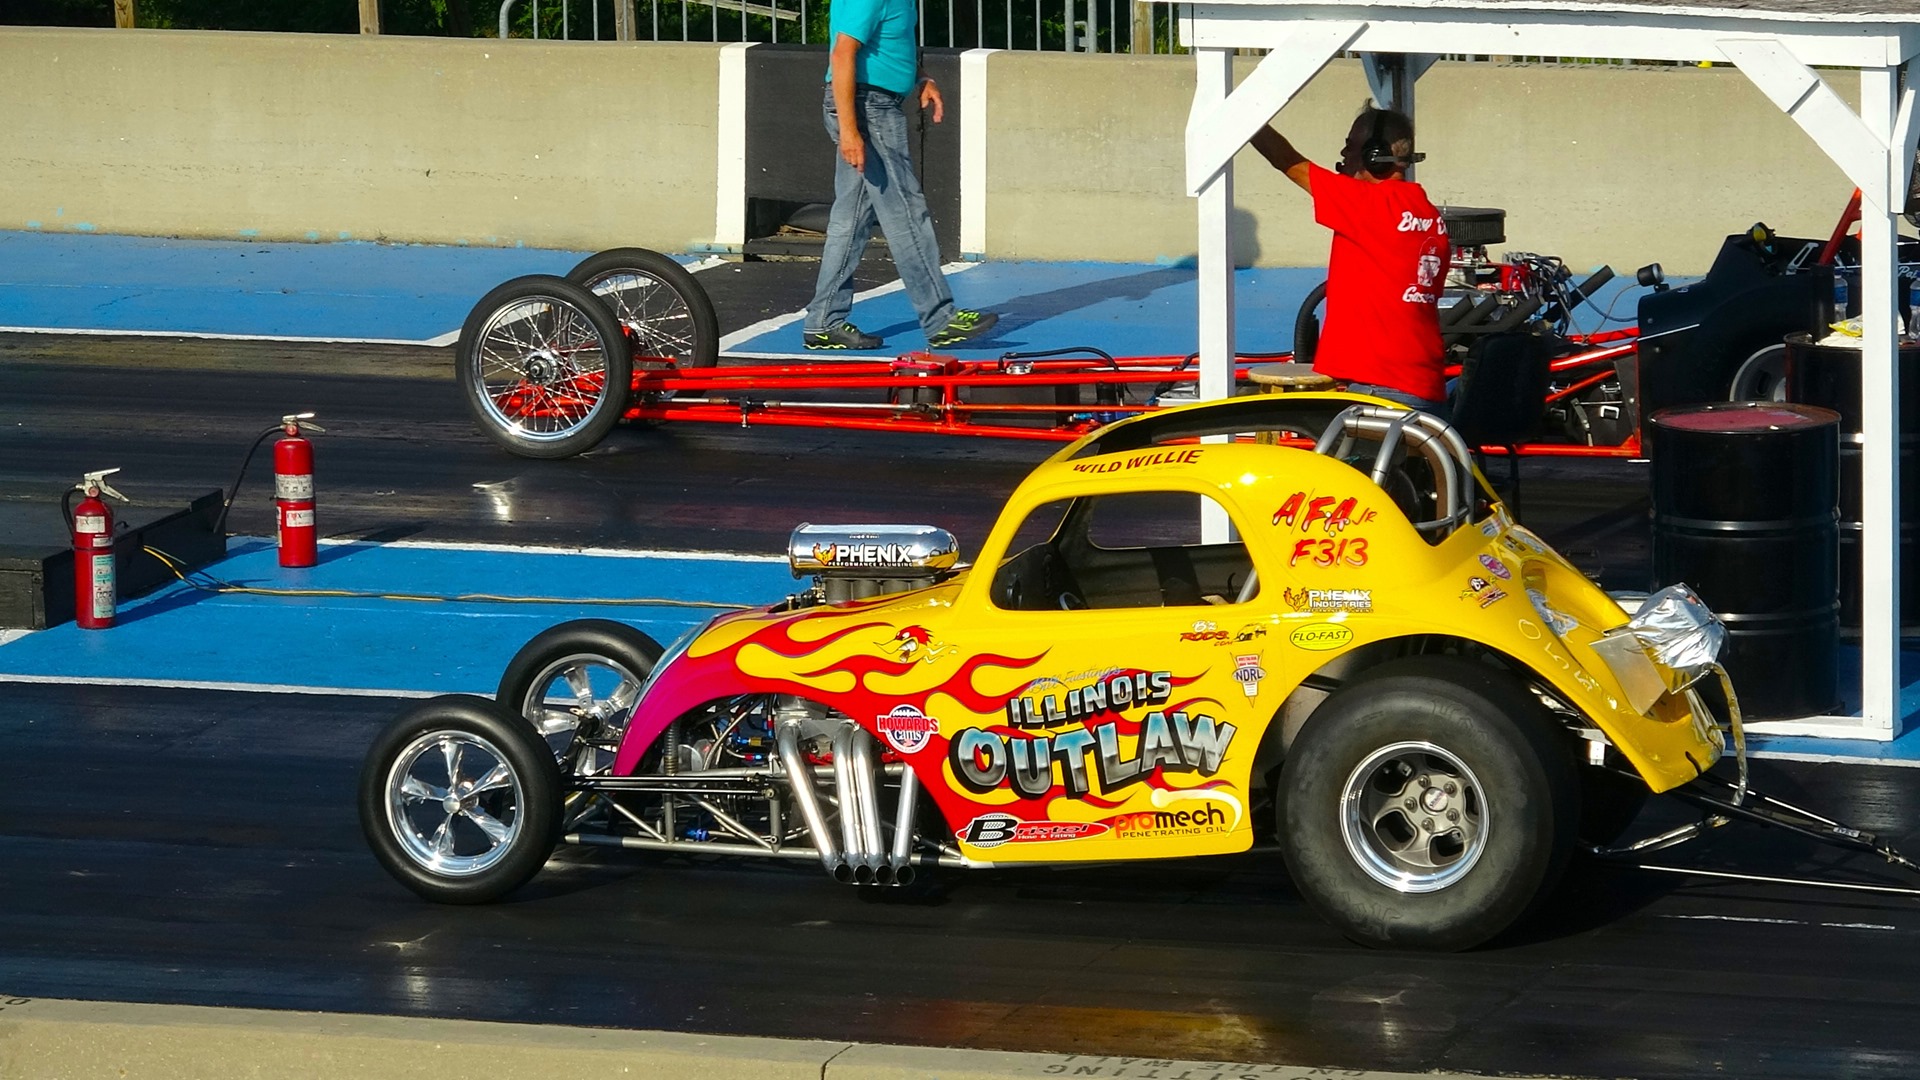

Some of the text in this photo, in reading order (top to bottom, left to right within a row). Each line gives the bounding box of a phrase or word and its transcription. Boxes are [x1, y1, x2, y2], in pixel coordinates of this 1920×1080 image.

[1073, 461, 1122, 473] WILD
[1126, 450, 1204, 470] WILLIE
[836, 543, 913, 563] PHENIX
[1290, 537, 1369, 568] F313
[1308, 589, 1372, 602] PHENIX
[1313, 600, 1372, 608] INDUSTRIES
[1292, 630, 1350, 641] FLO-FAST
[1236, 668, 1263, 682] NDRL
[1005, 671, 1172, 729] ILLINOIS
[878, 717, 939, 732] HOWARDS
[950, 711, 1238, 800] OUTLAW
[1114, 802, 1226, 839] promech
[1122, 828, 1201, 838] PENETRATING
[1197, 1063, 1282, 1074] THE
